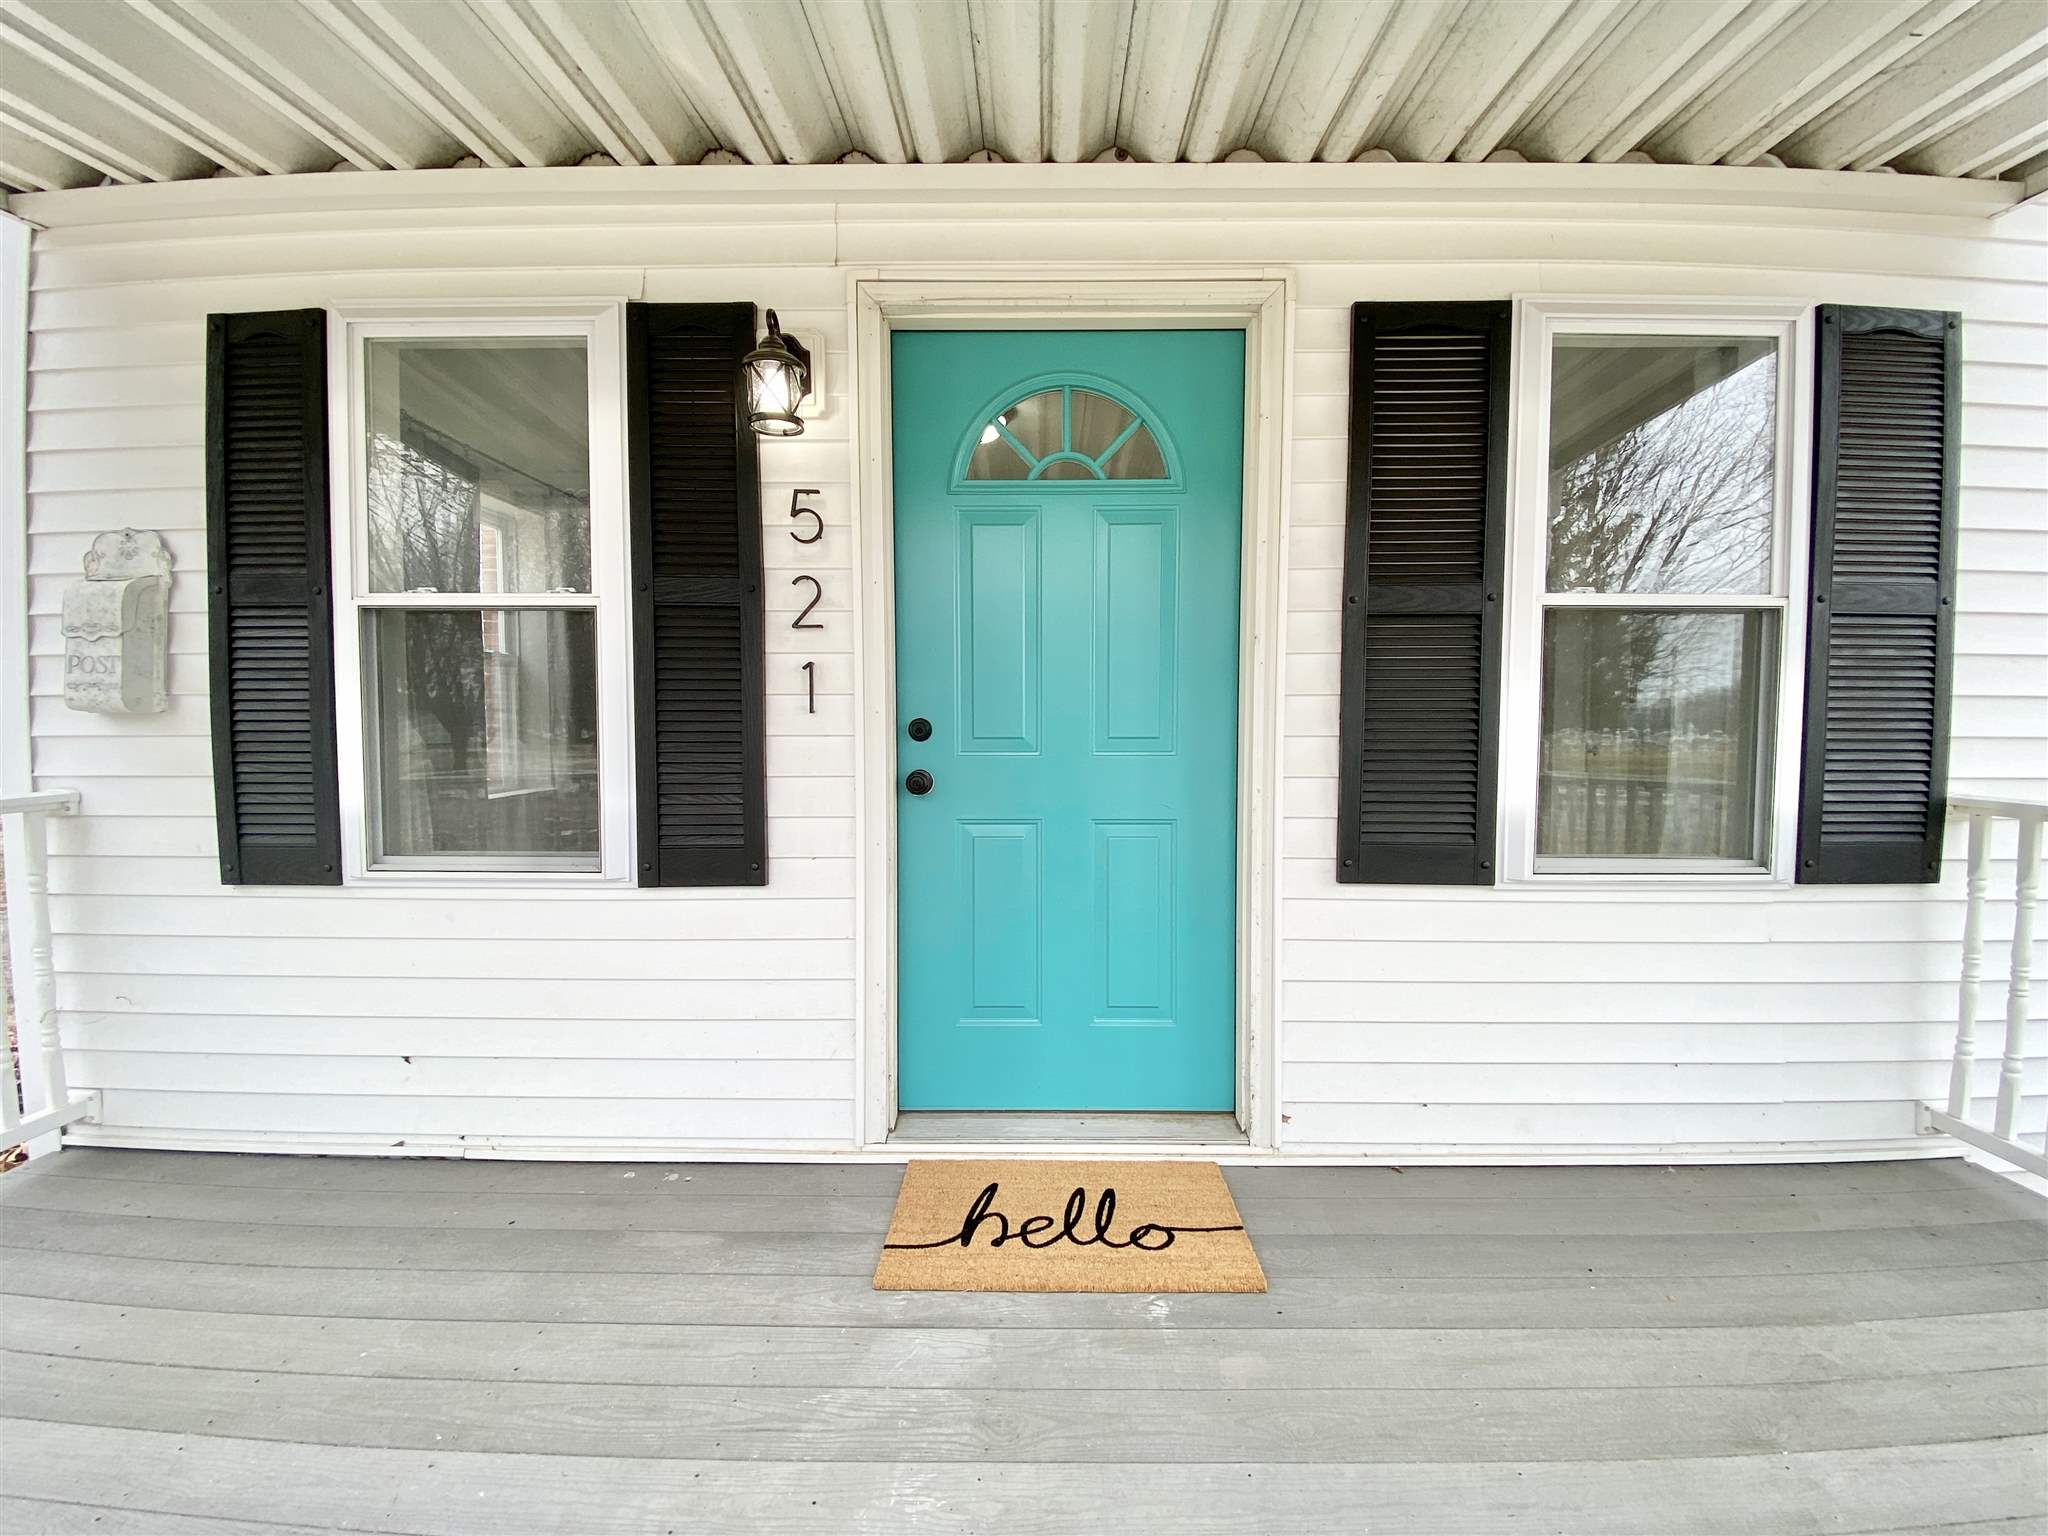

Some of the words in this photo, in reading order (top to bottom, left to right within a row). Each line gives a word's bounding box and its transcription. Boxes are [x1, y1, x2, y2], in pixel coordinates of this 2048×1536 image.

[790, 488, 824, 714] 521
[66, 655, 120, 674] POST
[883, 1182, 1244, 1251] hello
